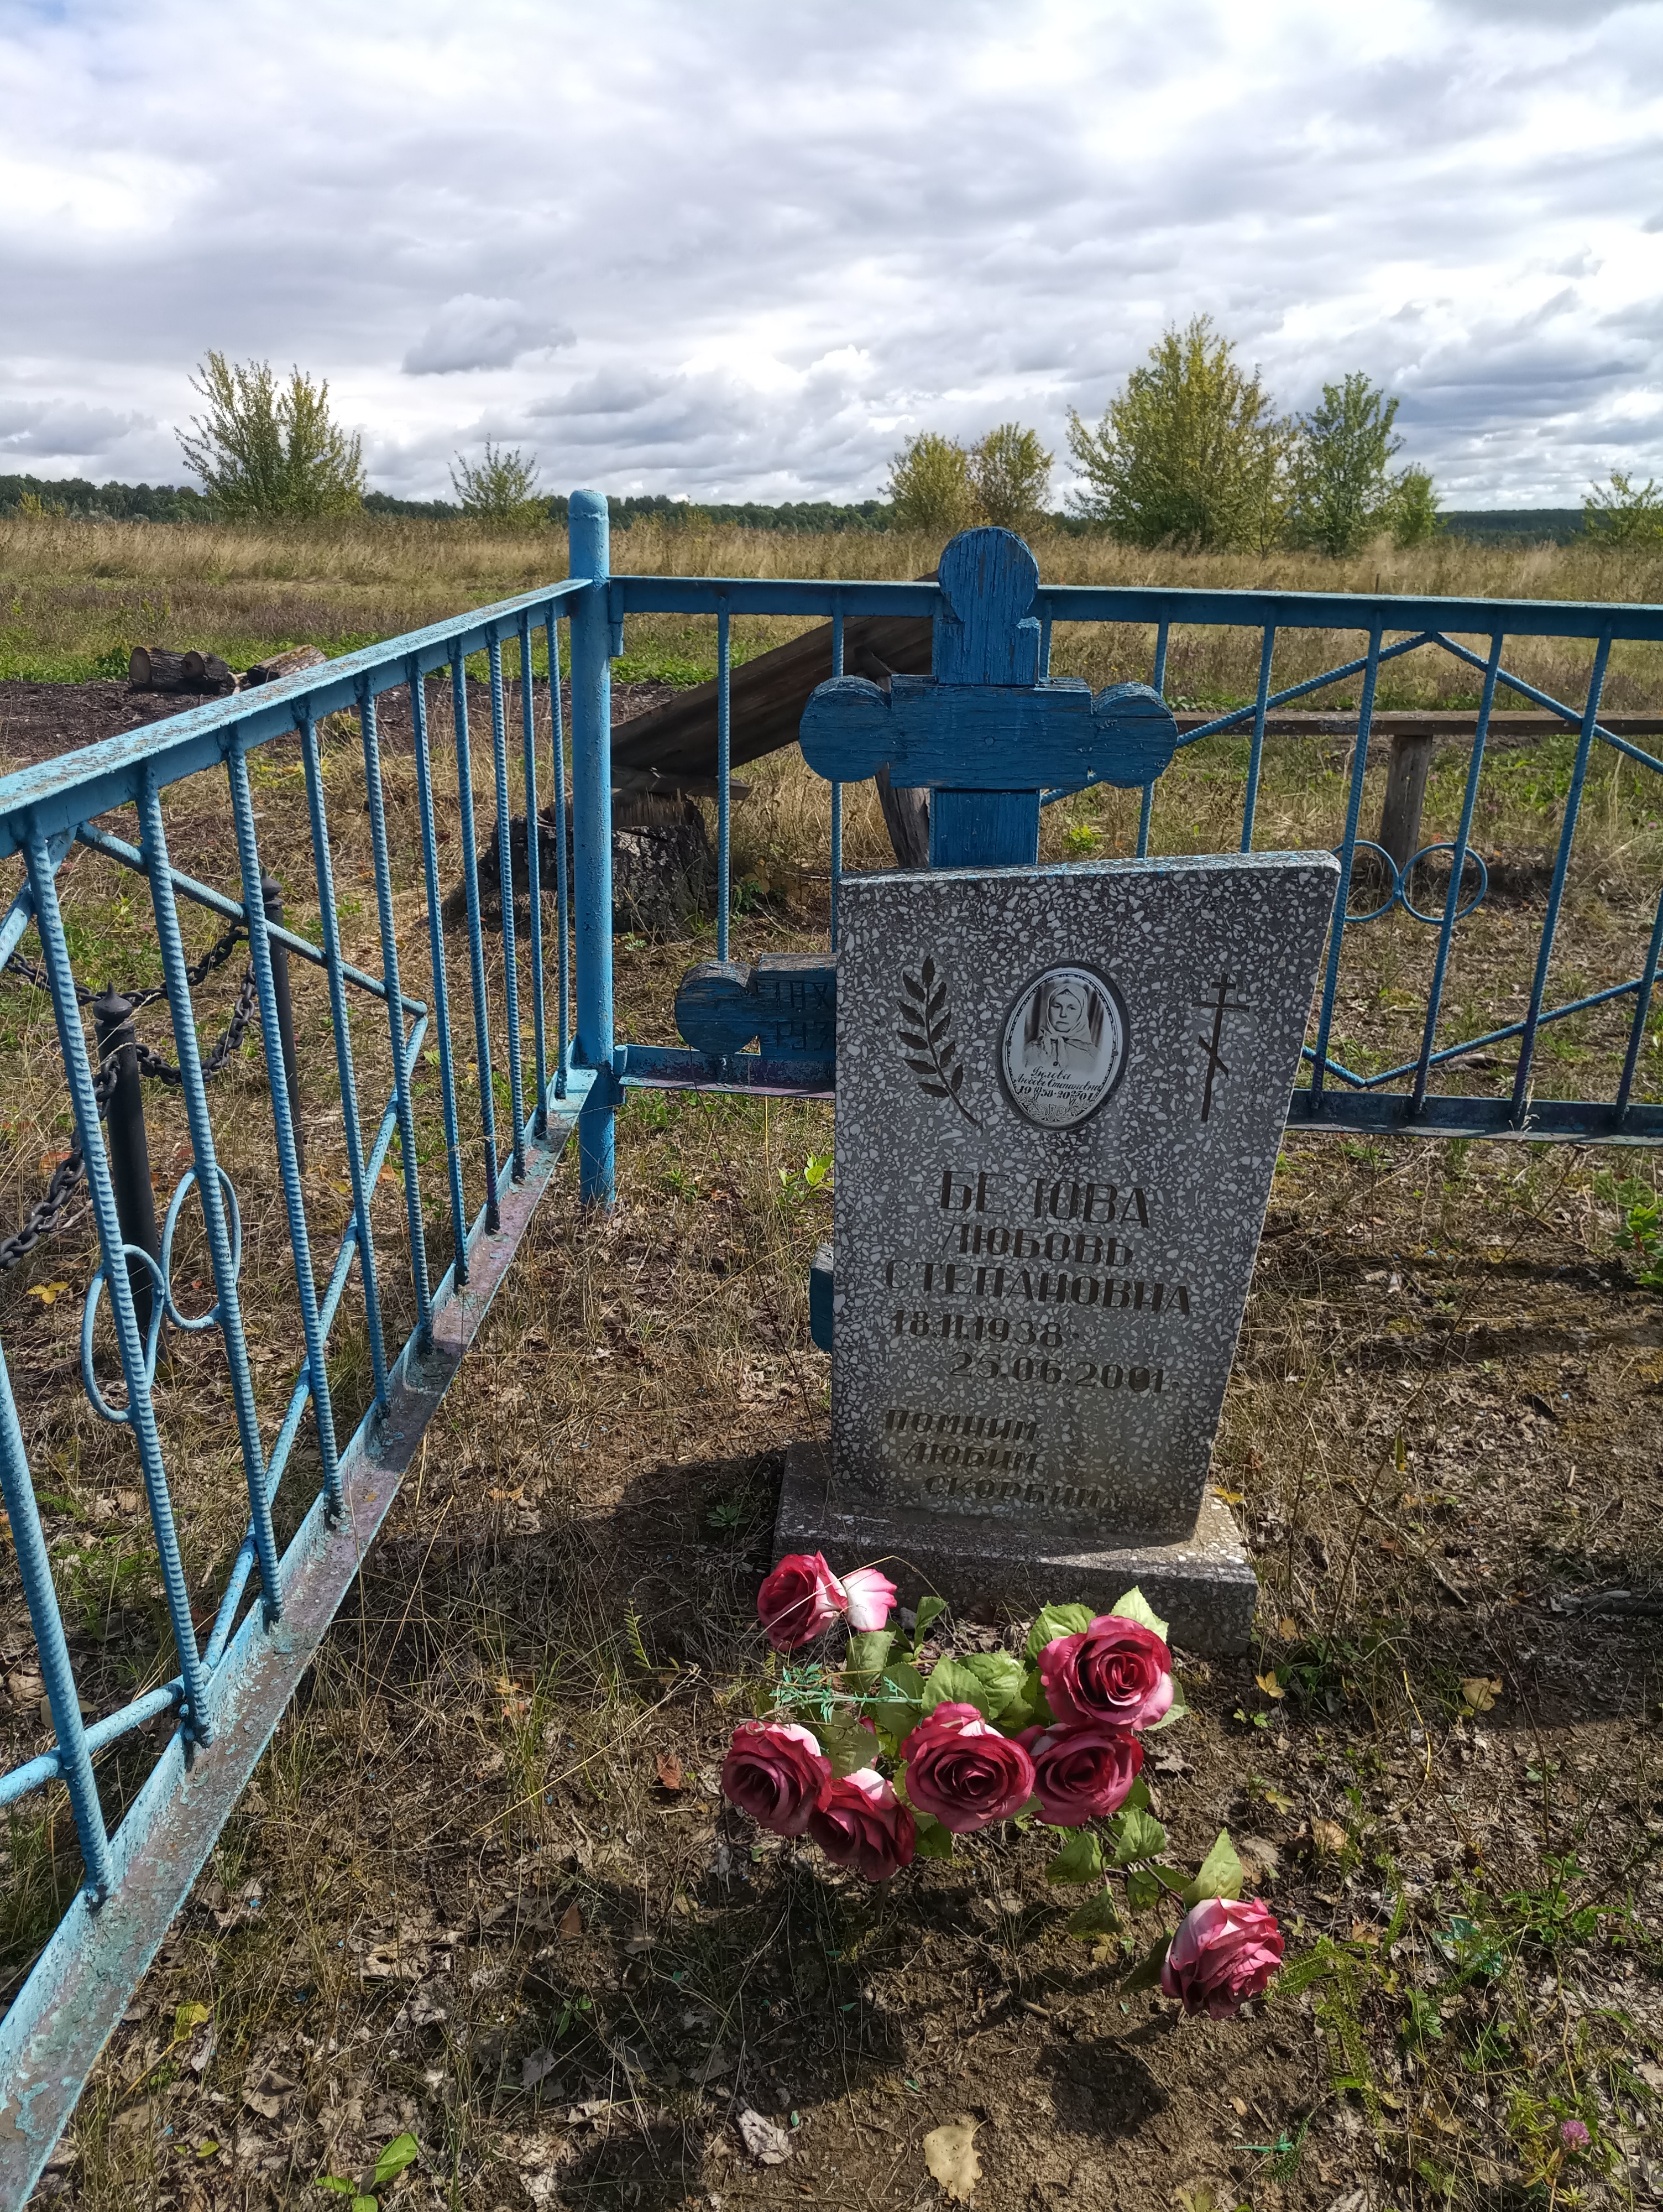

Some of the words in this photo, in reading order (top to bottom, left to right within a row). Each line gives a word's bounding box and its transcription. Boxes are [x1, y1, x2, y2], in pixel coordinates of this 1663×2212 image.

[940, 1170, 1149, 1228] БЕЛОВА
[942, 1223, 1134, 1267] ЛЮБОВЬ
[886, 1259, 1190, 1315] СТЕПАНОВНА
[885, 1409, 1038, 1441] ПОМНИМ
[903, 1442, 1038, 1472] ЛЮБИМ
[925, 1475, 1102, 1507] СКОРБИМ
